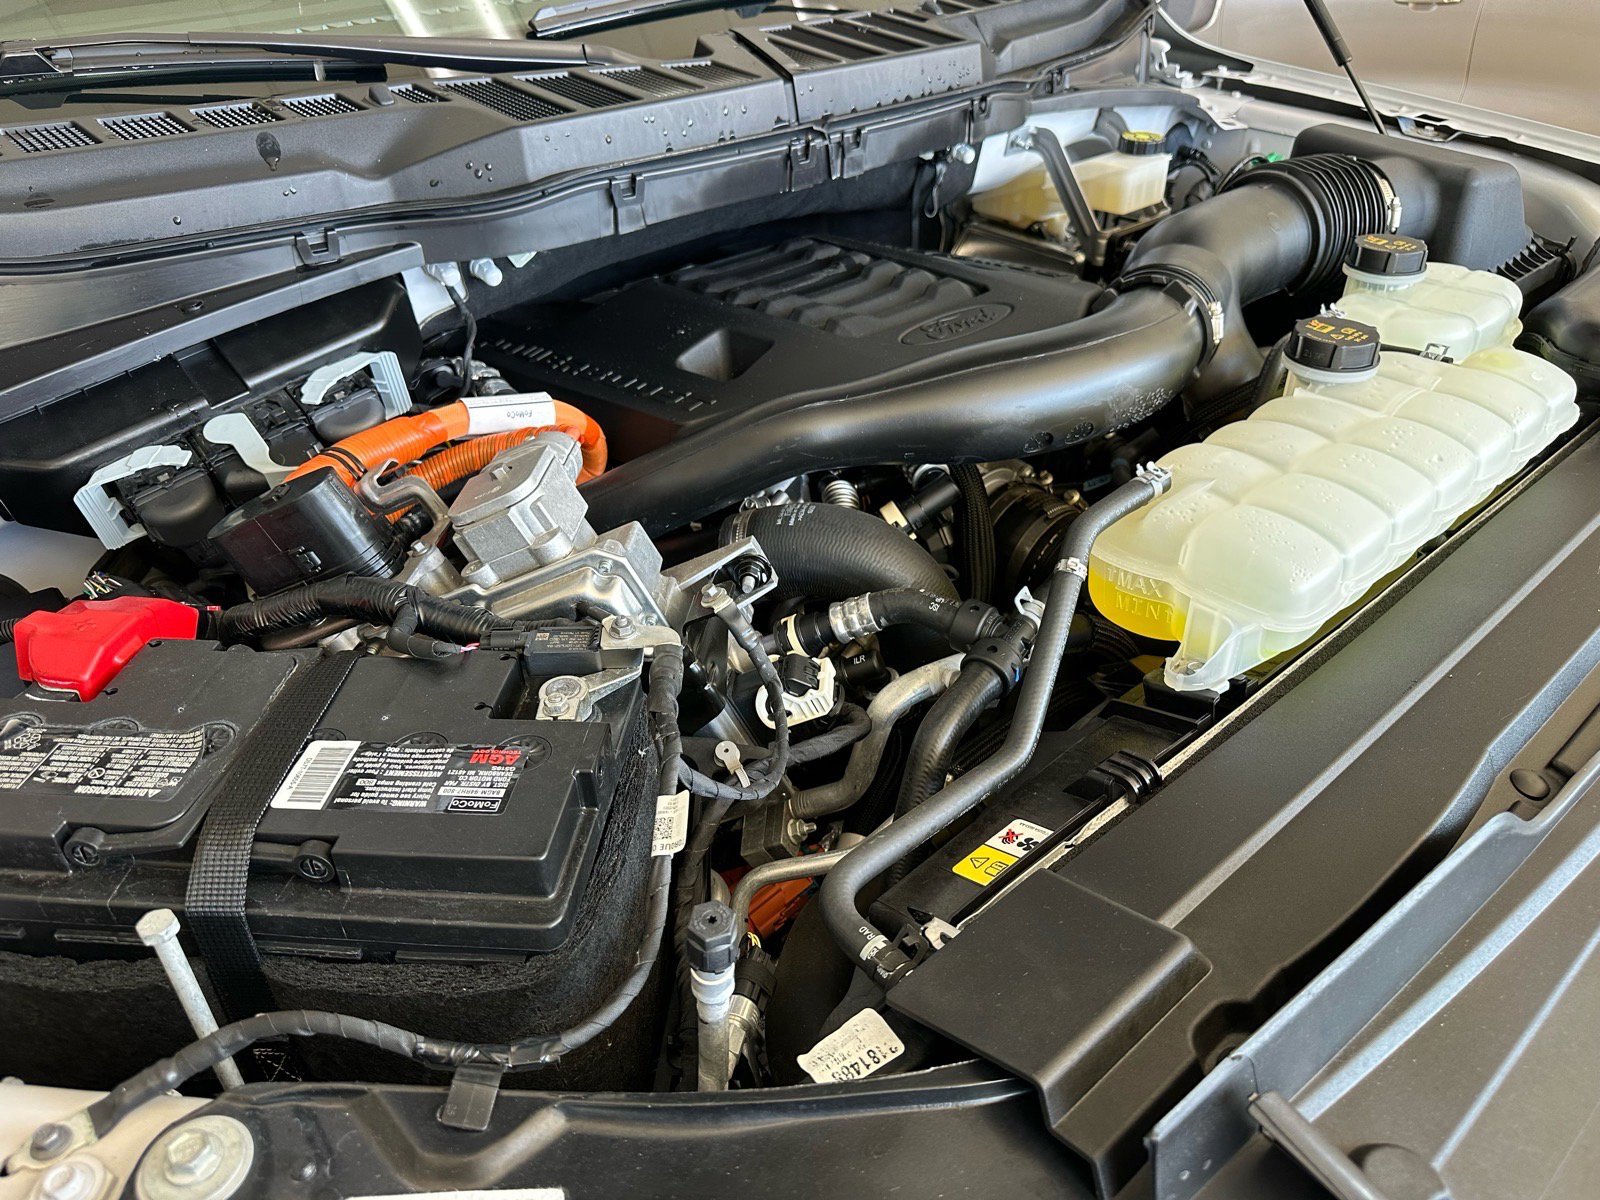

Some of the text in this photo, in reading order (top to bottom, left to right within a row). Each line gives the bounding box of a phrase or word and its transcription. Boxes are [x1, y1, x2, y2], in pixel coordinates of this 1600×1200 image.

[506, 410, 533, 420] FoMoCo
[1117, 568, 1164, 598] MAX
[1115, 592, 1161, 621] MIN
[469, 753, 520, 765] AGM
[74, 785, 148, 796] DANGER/POISON
[389, 799, 427, 807] WARNING:
[452, 800, 499, 809] FoMoCo
[858, 926, 876, 941] RAD
